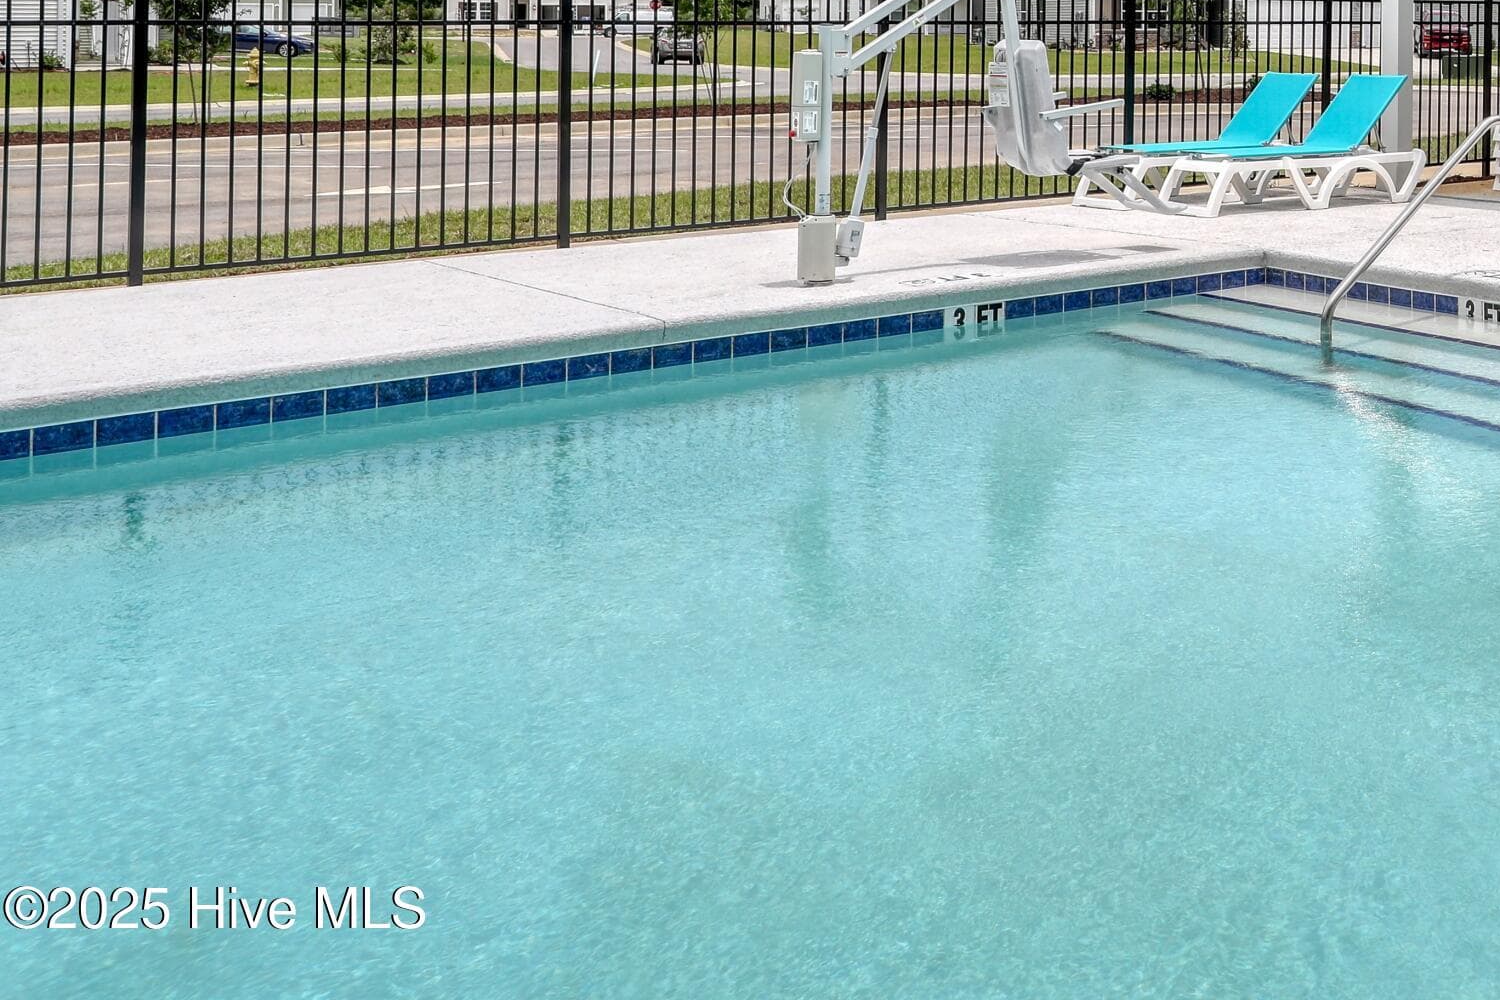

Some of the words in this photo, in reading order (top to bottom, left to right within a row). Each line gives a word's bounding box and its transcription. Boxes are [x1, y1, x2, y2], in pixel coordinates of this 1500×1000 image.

[954, 307, 966, 326] 3
[977, 302, 1003, 323] FT
[1465, 299, 1475, 318] 3
